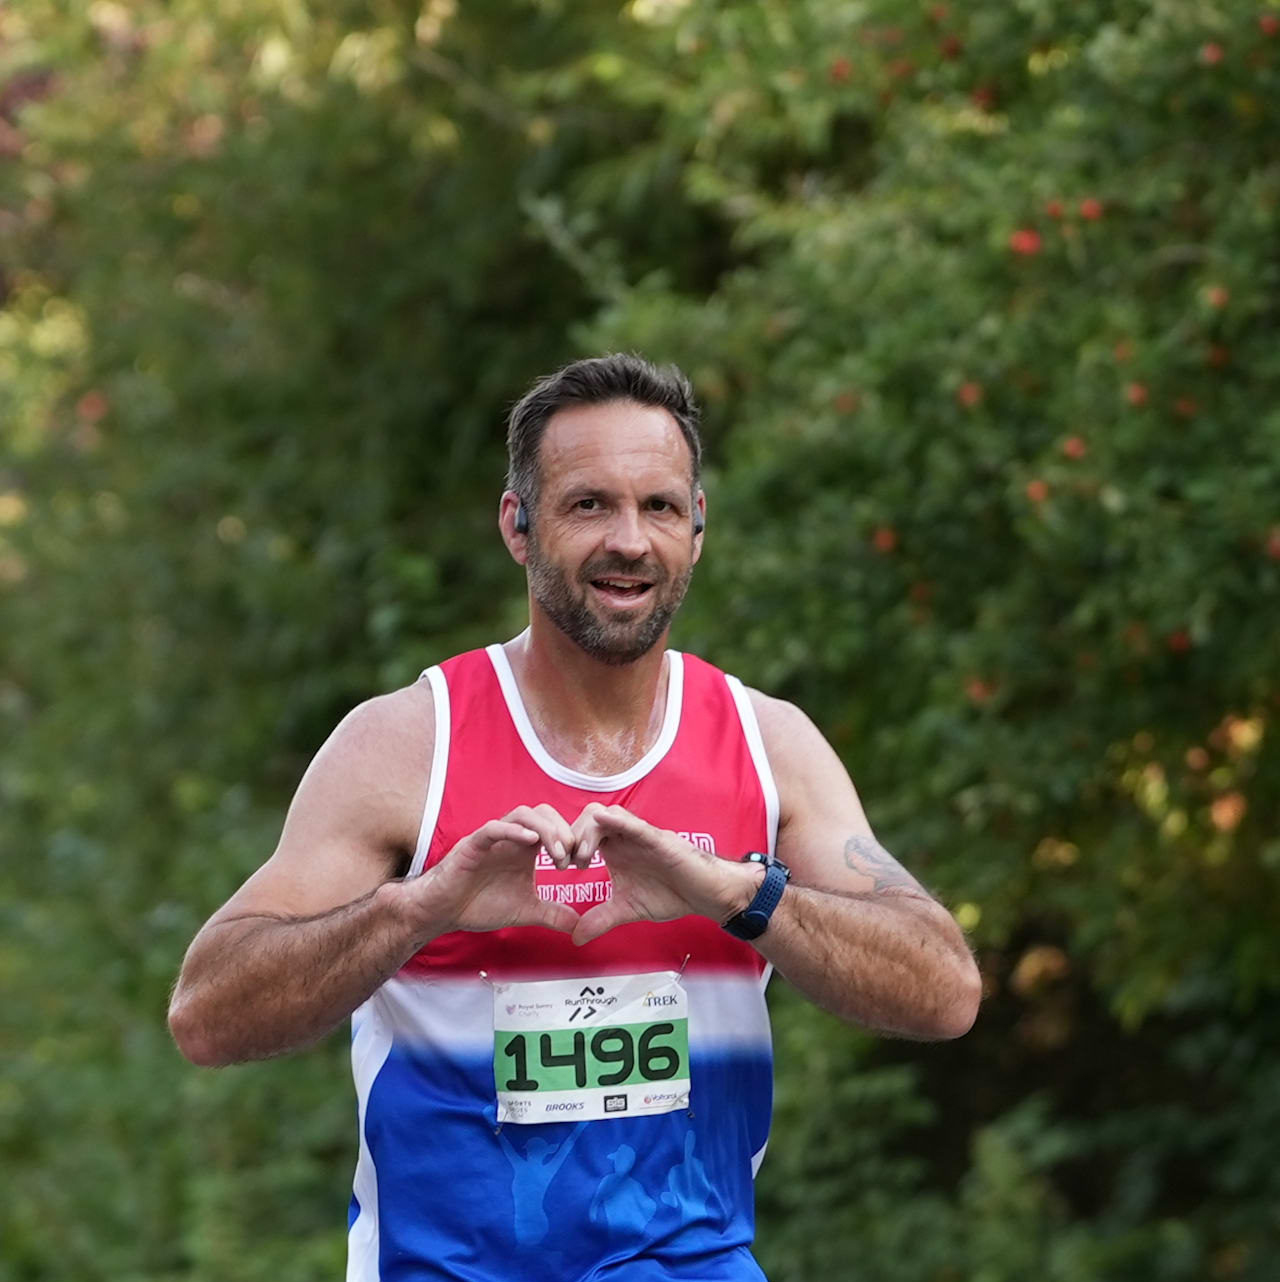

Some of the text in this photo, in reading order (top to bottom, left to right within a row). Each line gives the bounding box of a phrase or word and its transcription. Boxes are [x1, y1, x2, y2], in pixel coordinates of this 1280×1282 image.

[565, 996, 618, 1006] RunThrough
[647, 994, 678, 1007] TREK
[504, 1023, 680, 1092] 1496
[545, 1102, 584, 1112] BROOKS
